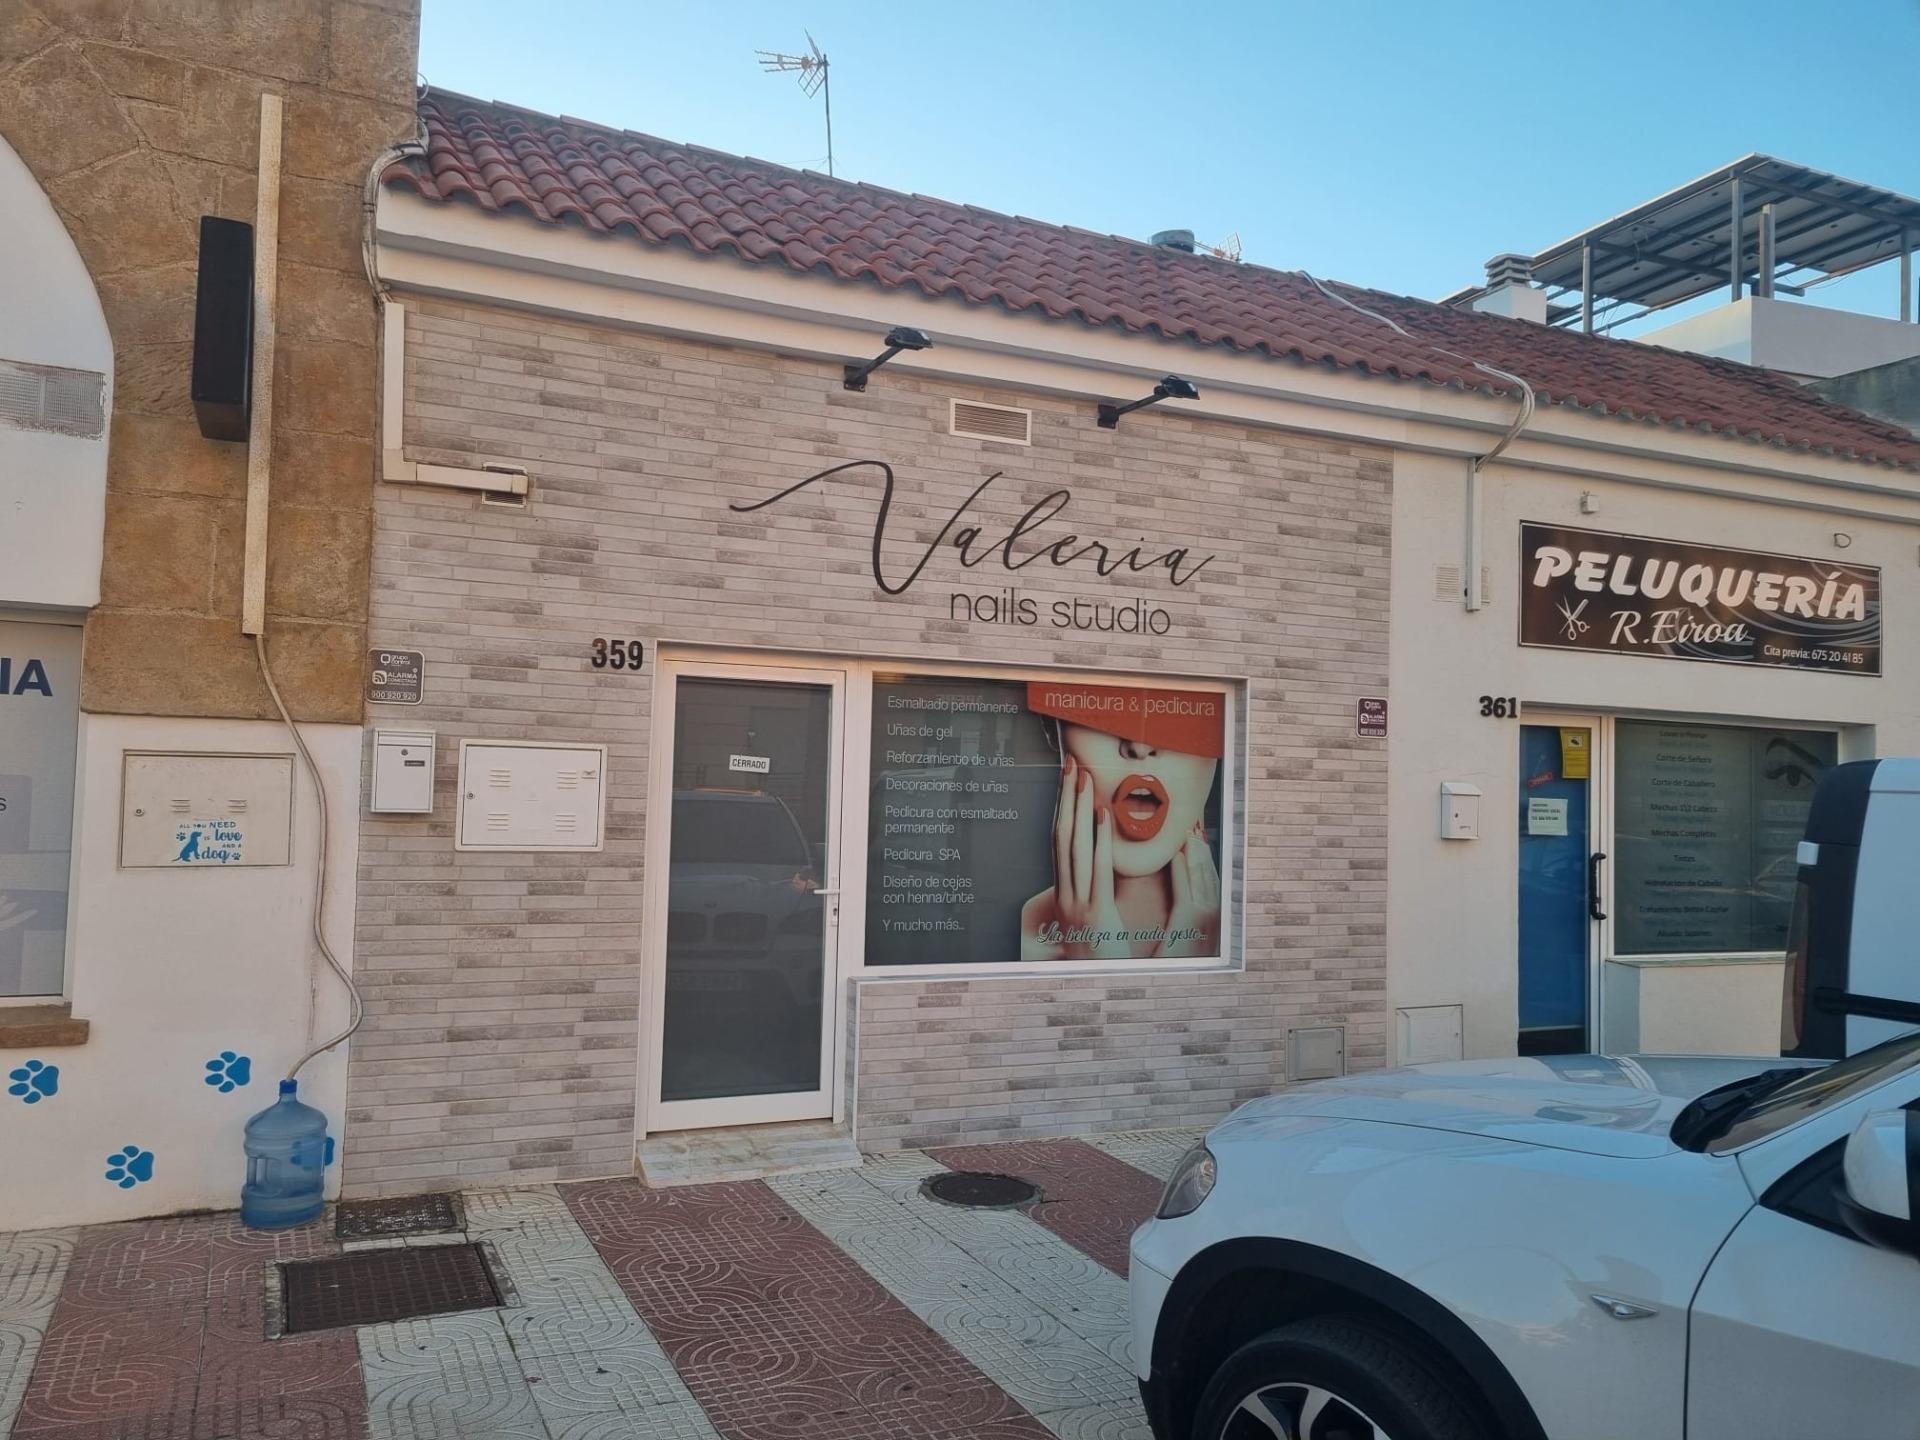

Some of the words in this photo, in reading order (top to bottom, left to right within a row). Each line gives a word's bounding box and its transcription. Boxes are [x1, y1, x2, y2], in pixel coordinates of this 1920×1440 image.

[729, 460, 1216, 595] Valeria
[1532, 546, 1866, 621] PELUQUERÍA
[950, 587, 1038, 625] nails
[1051, 597, 1171, 635] studio
[591, 637, 643, 670] 359
[1763, 644, 1780, 657] Cita
[1782, 646, 1811, 661] previa:
[1811, 648, 1828, 661] 675
[1829, 649, 1841, 662] 20
[1842, 650, 1852, 663] 41
[1852, 651, 1864, 664] 85
[887, 696, 948, 711] Esmaltado
[951, 700, 1018, 714] permanente
[1044, 691, 1124, 711] manicura
[1129, 696, 1140, 711] &
[1144, 697, 1216, 718] pedicura
[1479, 695, 1517, 718] 361
[887, 723, 916, 736] Uñas
[919, 724, 933, 737] de
[936, 725, 953, 740] gel
[732, 758, 767, 769] CERRADO
[887, 750, 969, 765] Reforzamiento
[971, 753, 986, 766] de
[988, 753, 1015, 767] uñas
[886, 777, 962, 792] Decoraciones
[965, 780, 979, 792] de
[982, 780, 1009, 793] uñas
[885, 805, 934, 818] Pedicura
[936, 807, 957, 819] con
[960, 807, 1018, 820] esmaltado
[215, 829, 243, 841] love
[884, 822, 955, 836] permanente
[201, 846, 230, 864] dog
[884, 847, 933, 861] Pedicura
[939, 848, 961, 861] SPA
[883, 874, 922, 888] Diseño
[925, 875, 940, 888] de
[942, 876, 972, 891] cejas
[883, 893, 905, 904] con
[907, 891, 975, 905] henna/tinte
[882, 919, 891, 931] Y
[893, 919, 933, 931] mucho
[1036, 920, 1063, 944] La
[1064, 925, 1110, 949] belleza
[1116, 928, 1130, 941] en
[1134, 925, 1166, 941] cada
